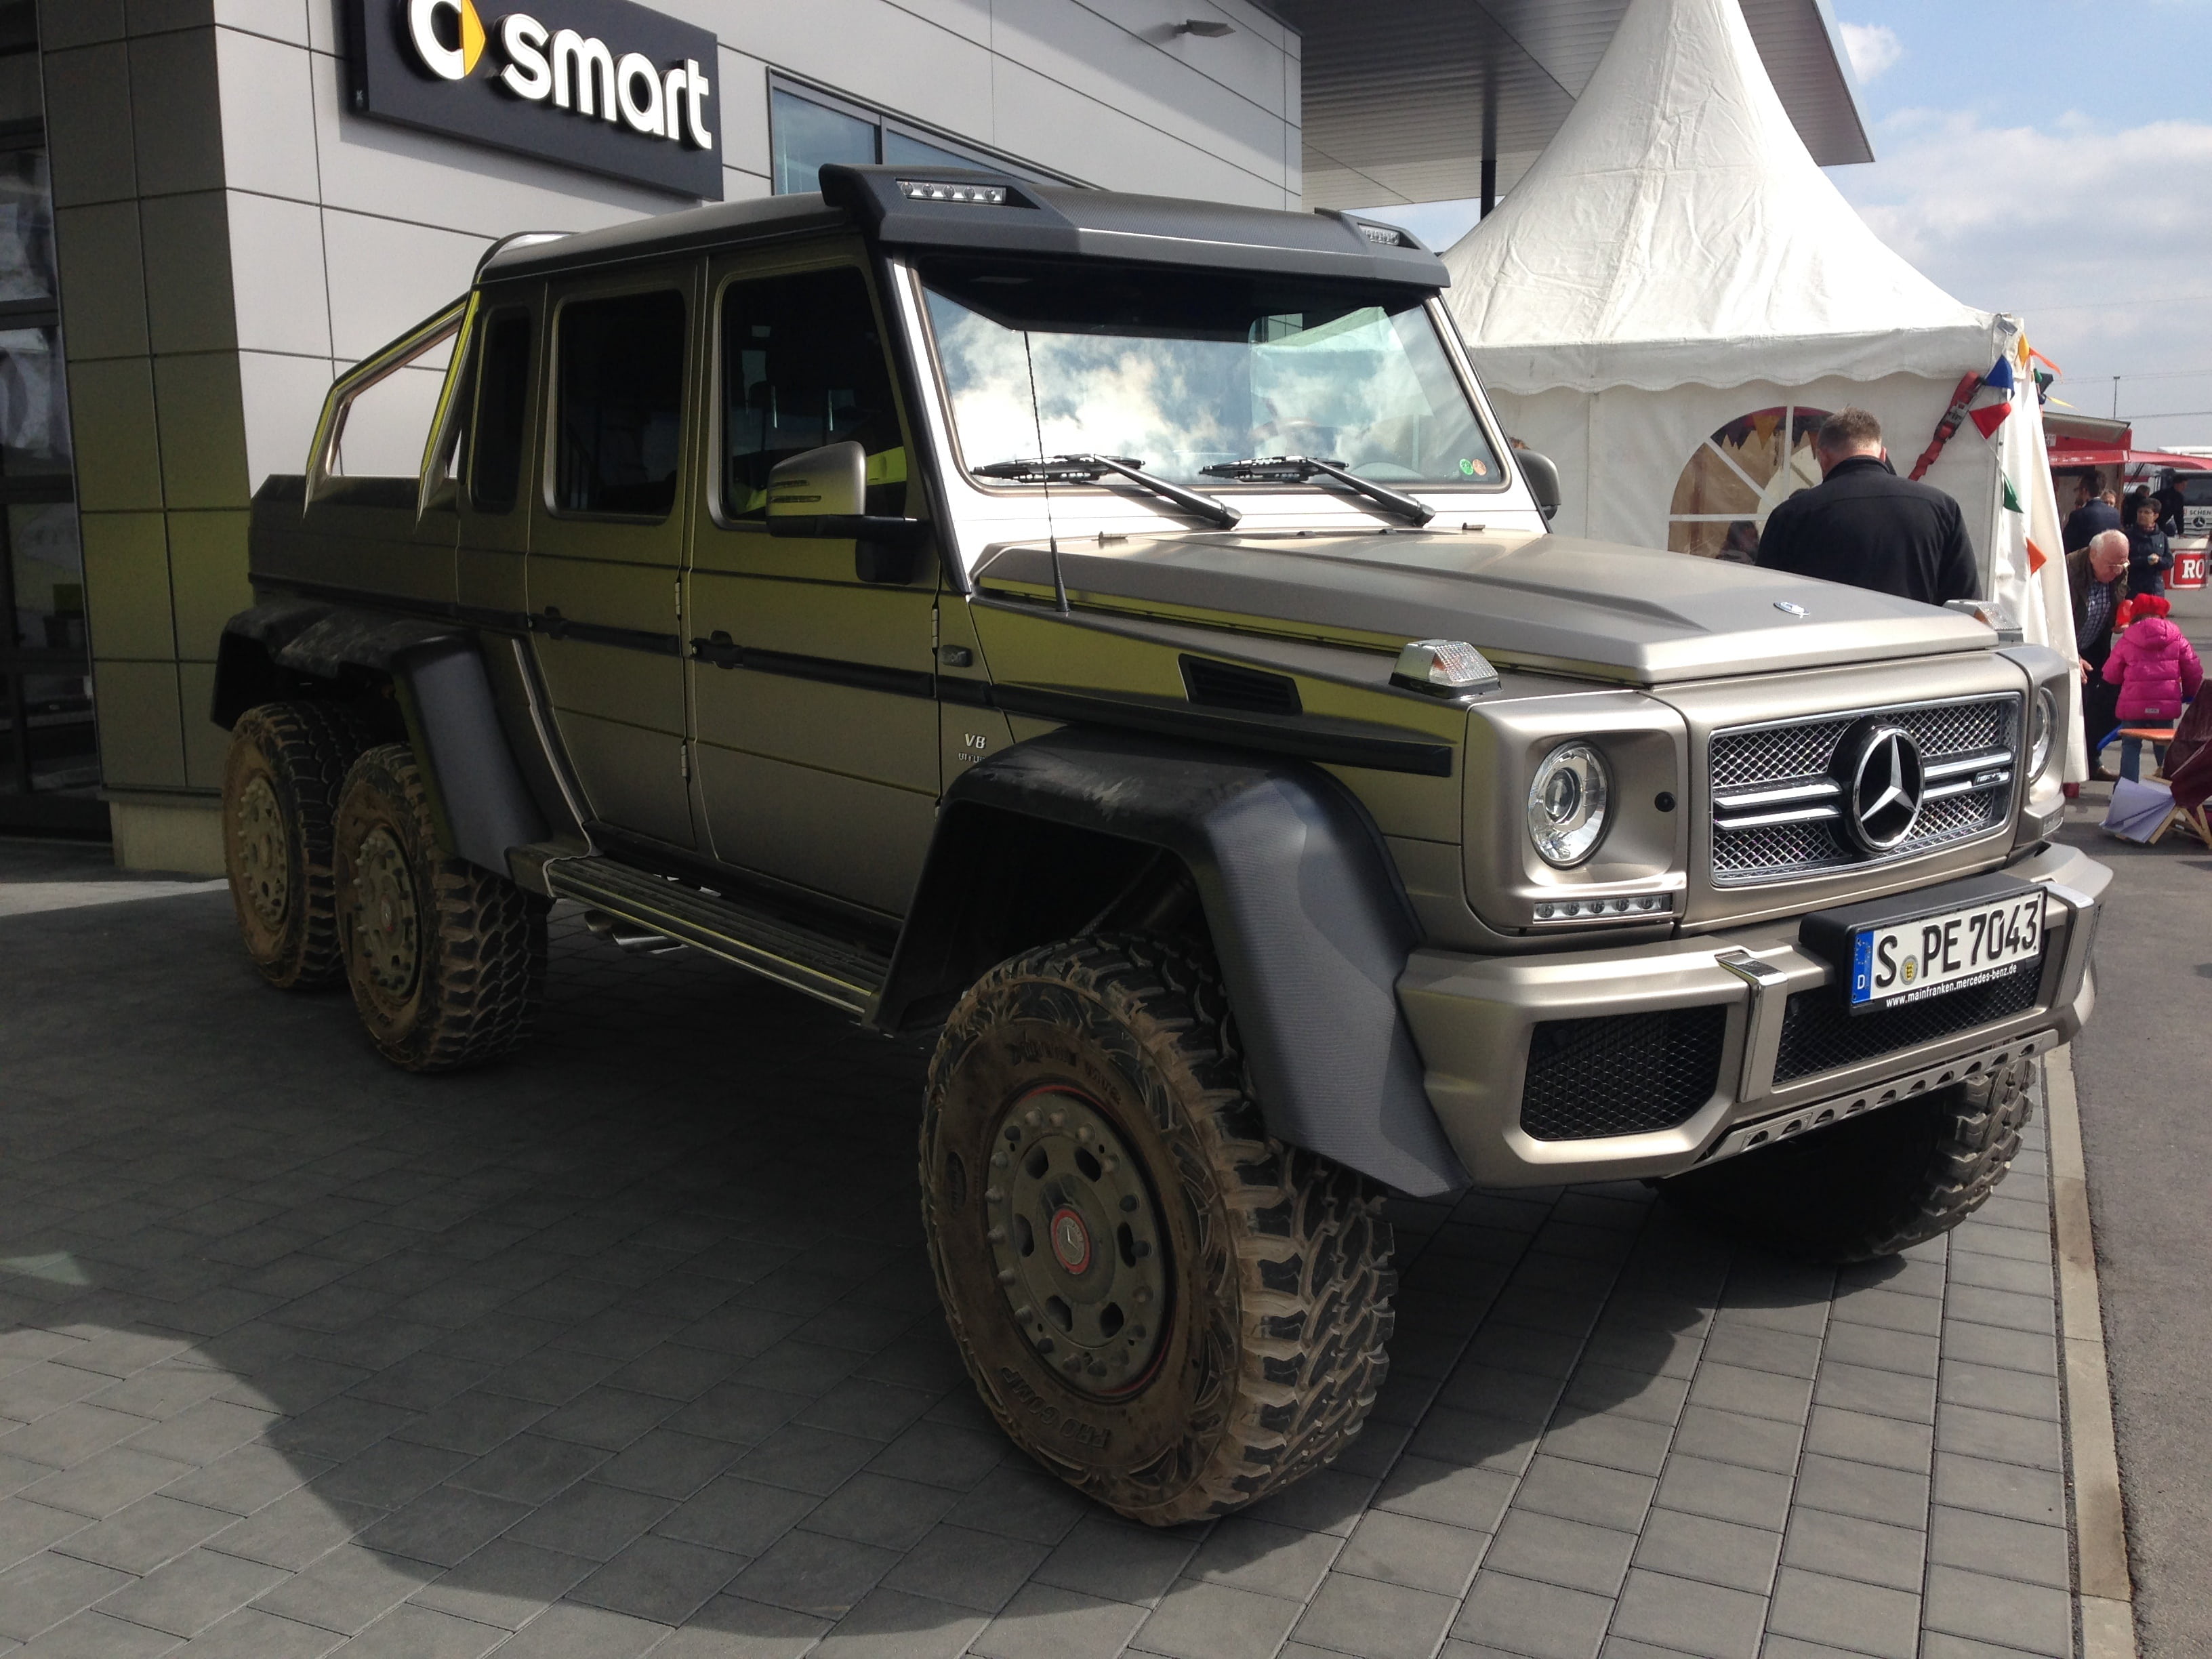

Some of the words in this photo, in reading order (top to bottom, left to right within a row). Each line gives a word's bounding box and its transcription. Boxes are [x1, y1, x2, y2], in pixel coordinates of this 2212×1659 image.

[499, 14, 712, 149] smart
[2182, 558, 2205, 579] RO
[965, 733, 986, 749] V8
[1875, 935, 1898, 987] S
[1921, 919, 1962, 977] PE
[1969, 899, 2039, 966] 7043
[1858, 974, 1865, 989] D
[1886, 964, 2018, 1008] www.mainfranken.mercedes-benz.de
